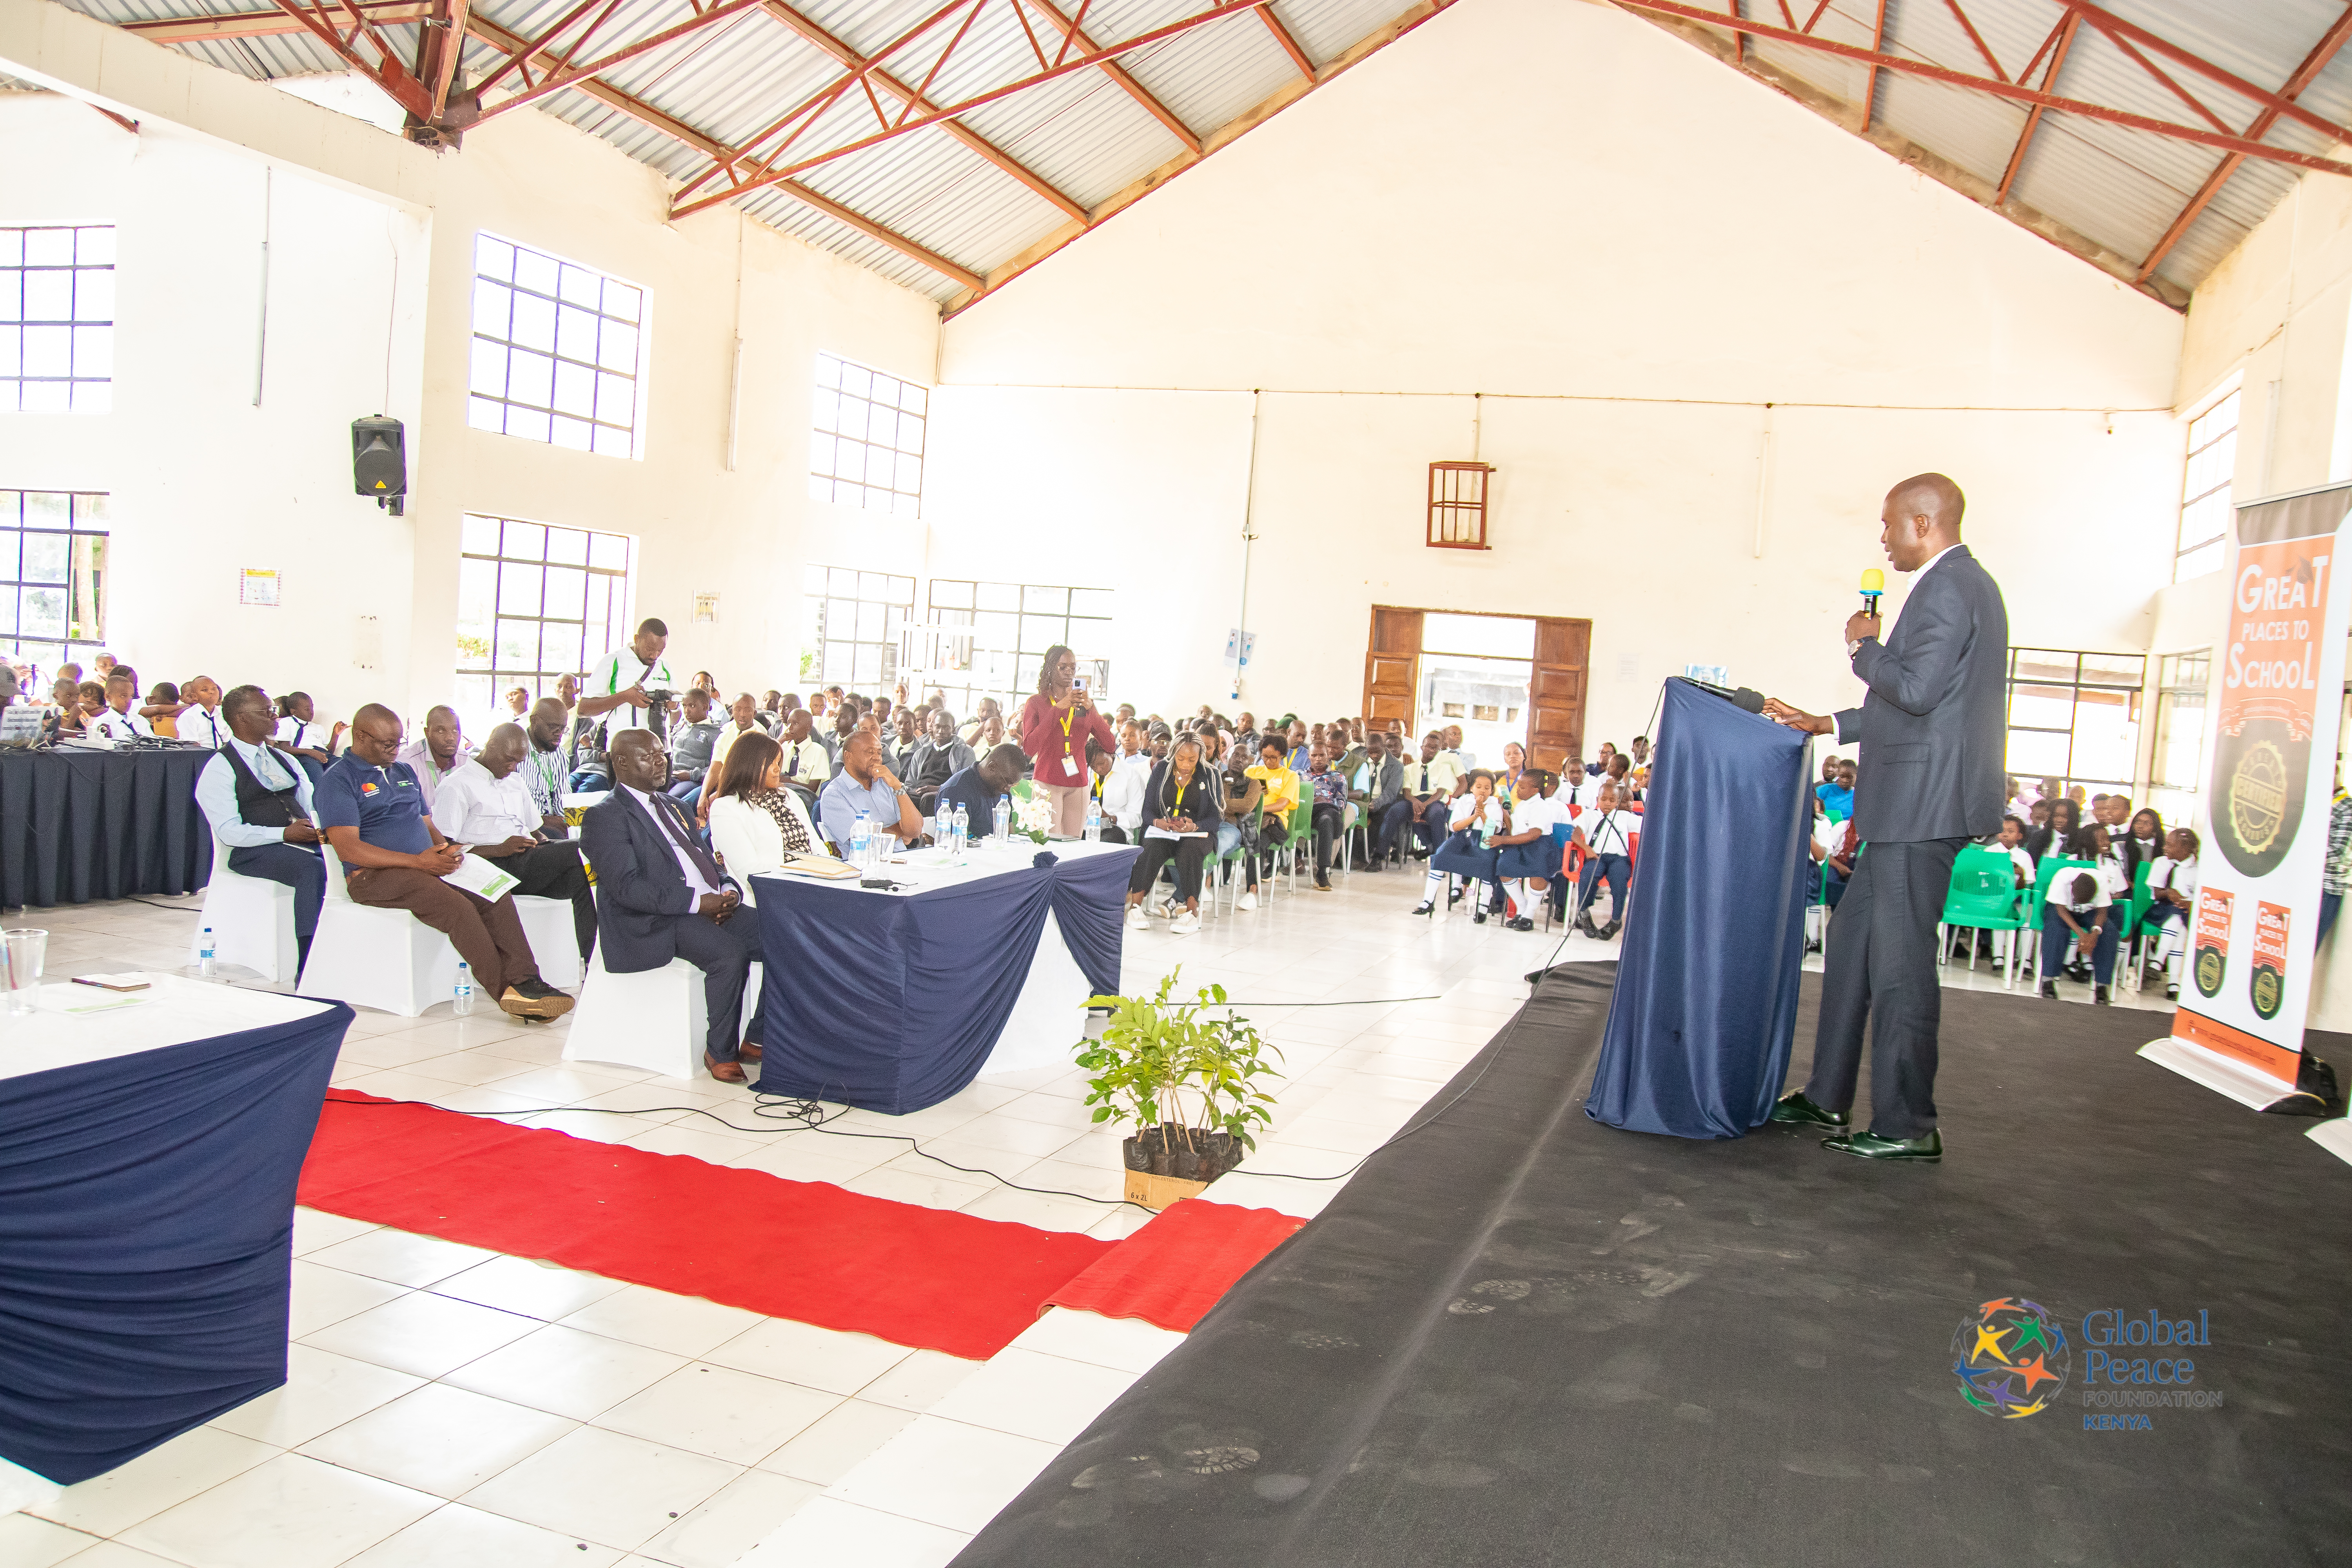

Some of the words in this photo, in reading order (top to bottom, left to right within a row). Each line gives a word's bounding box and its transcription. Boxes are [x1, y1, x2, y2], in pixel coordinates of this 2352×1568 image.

[2237, 555, 2329, 613] GREAT
[2241, 621, 2289, 641] PLACES
[2293, 619, 2309, 640] TO
[2226, 641, 2315, 689] SCHOOL
[1149, 1175, 1180, 1183] CHOLESTEROL
